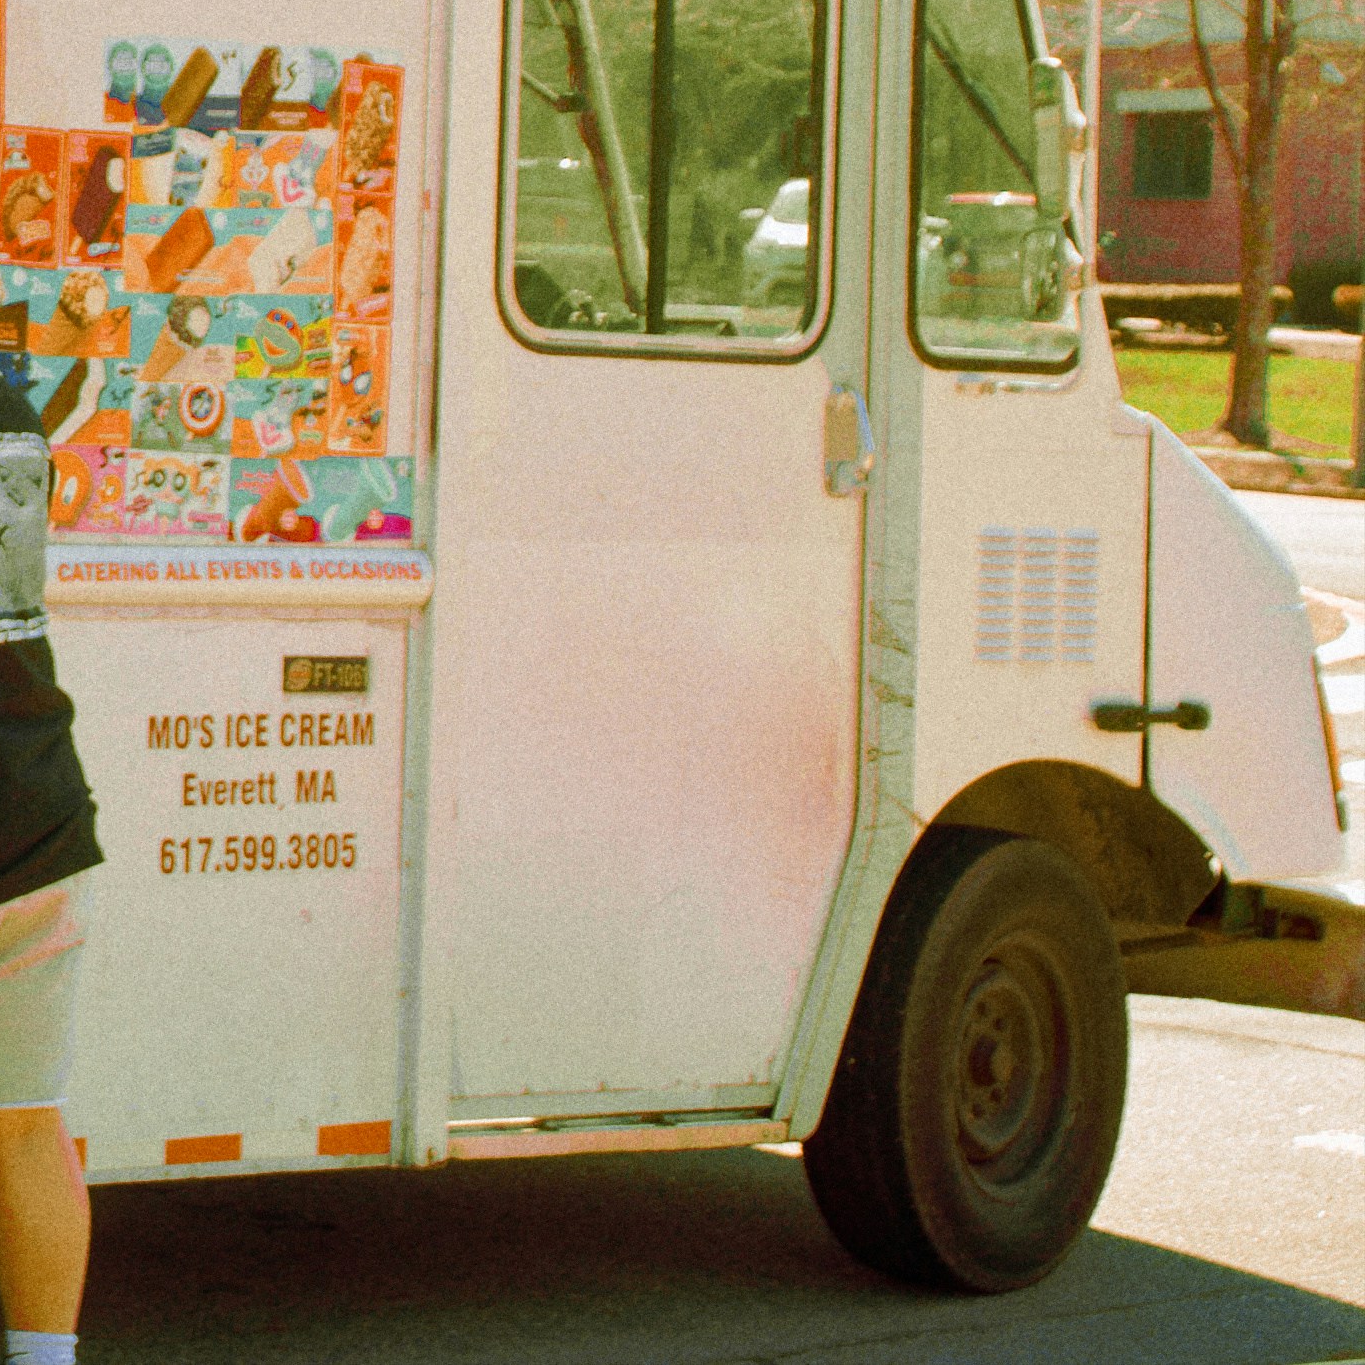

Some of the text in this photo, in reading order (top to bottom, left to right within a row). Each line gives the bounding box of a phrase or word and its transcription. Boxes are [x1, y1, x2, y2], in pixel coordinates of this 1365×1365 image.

[57, 560, 423, 583] CATERING ALL EVENTS & OCCASIONS
[147, 711, 375, 749] MO'S ICE CREAM
[294, 769, 336, 803] MA
[159, 833, 357, 874] 617.599.3805
